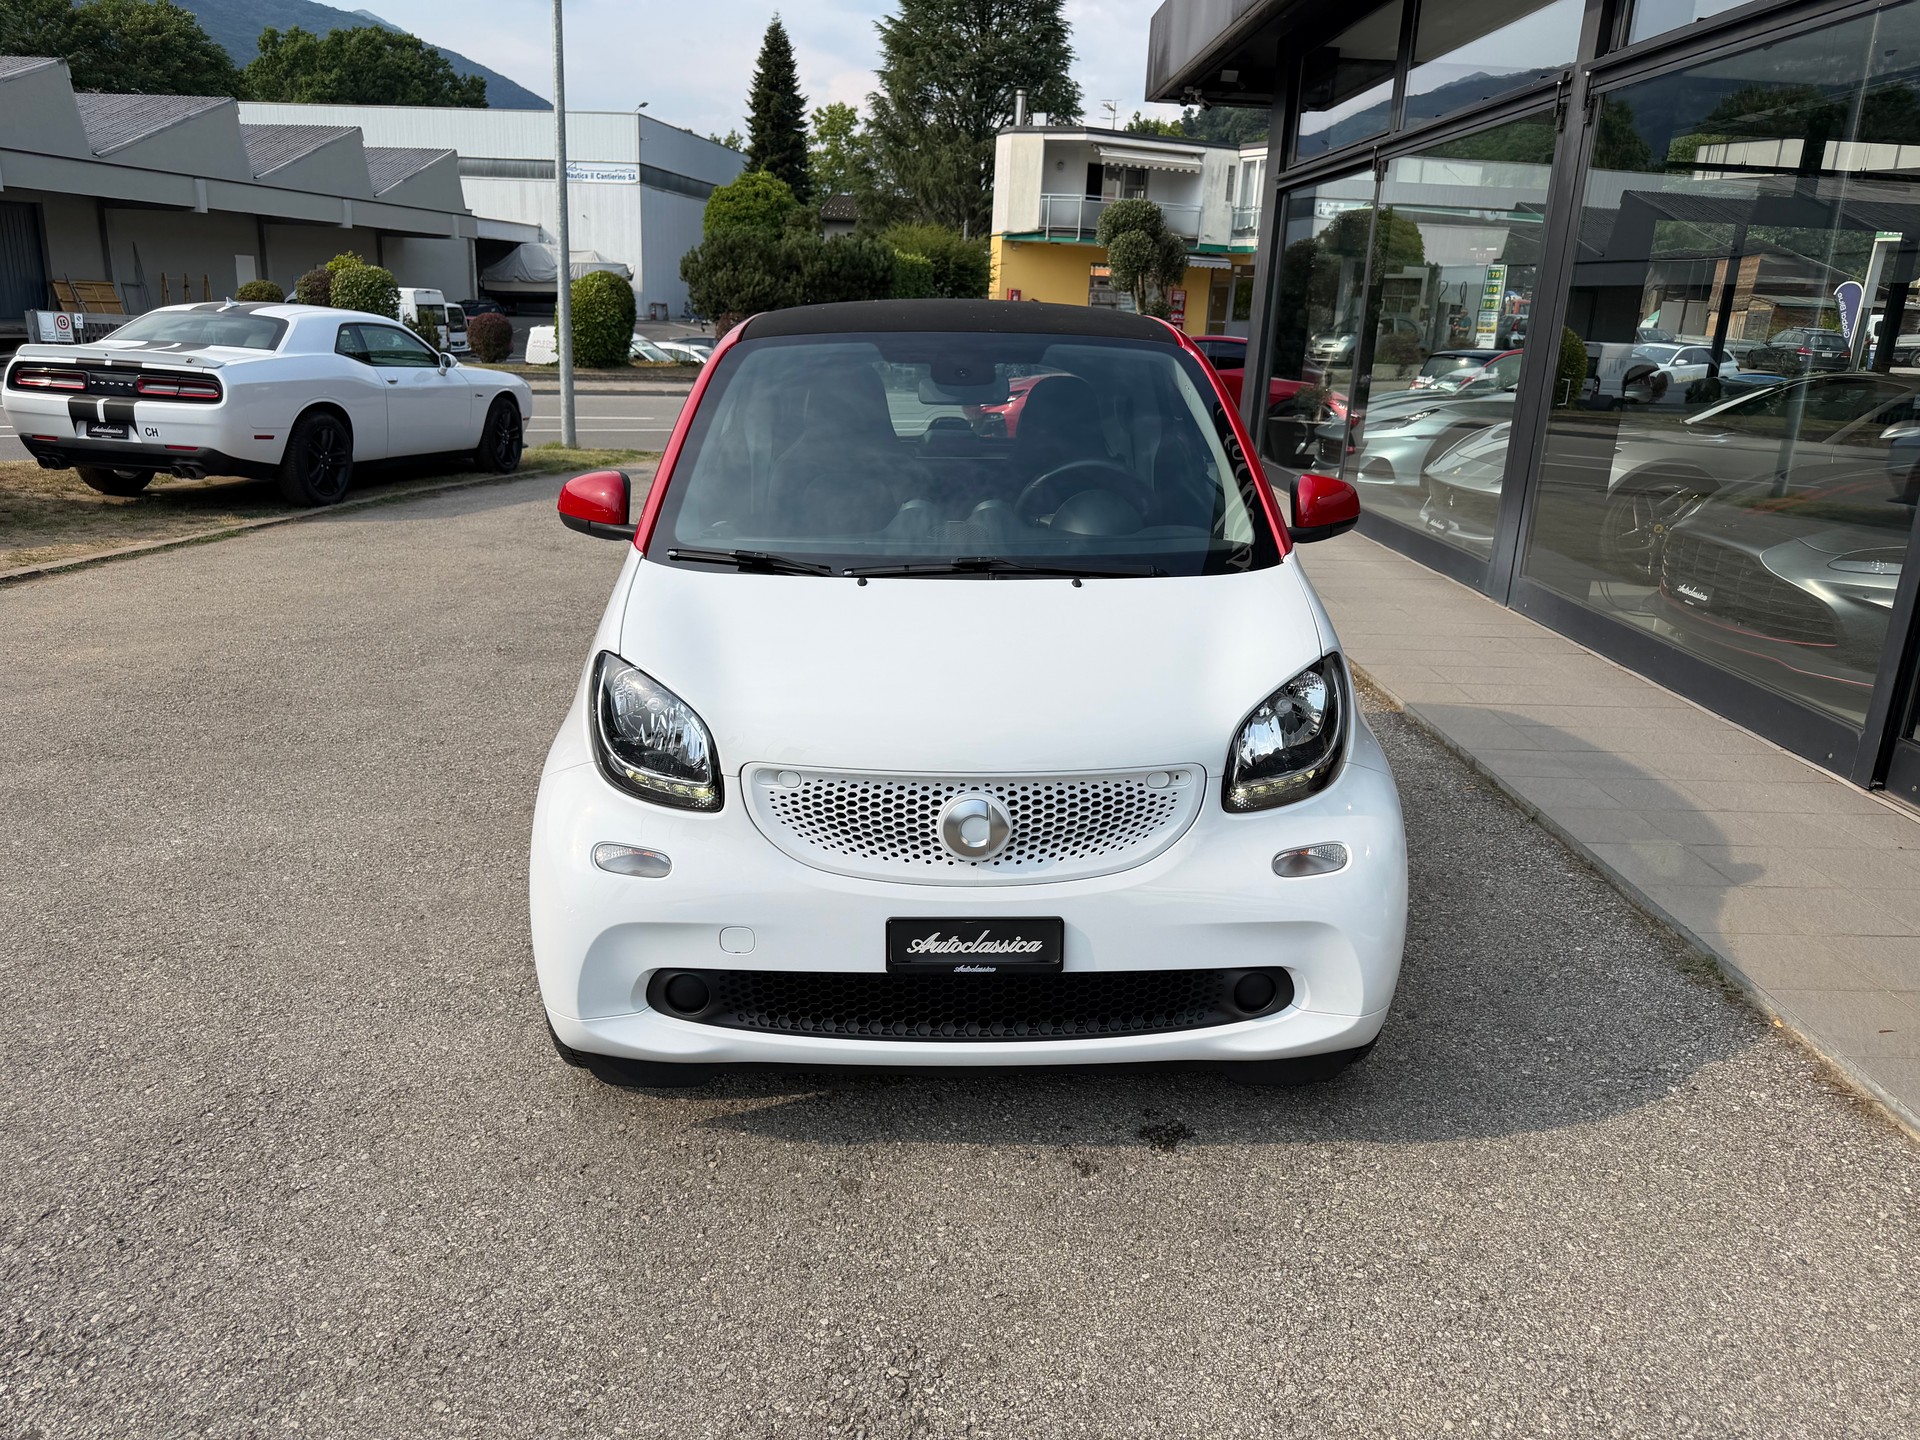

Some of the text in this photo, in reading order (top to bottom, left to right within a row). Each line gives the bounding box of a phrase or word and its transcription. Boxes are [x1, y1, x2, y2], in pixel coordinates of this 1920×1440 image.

[60, 319, 67, 327] 15
[145, 427, 159, 438] CH
[906, 929, 1043, 954] Autoclassica
[953, 964, 996, 973] Autoclassica
